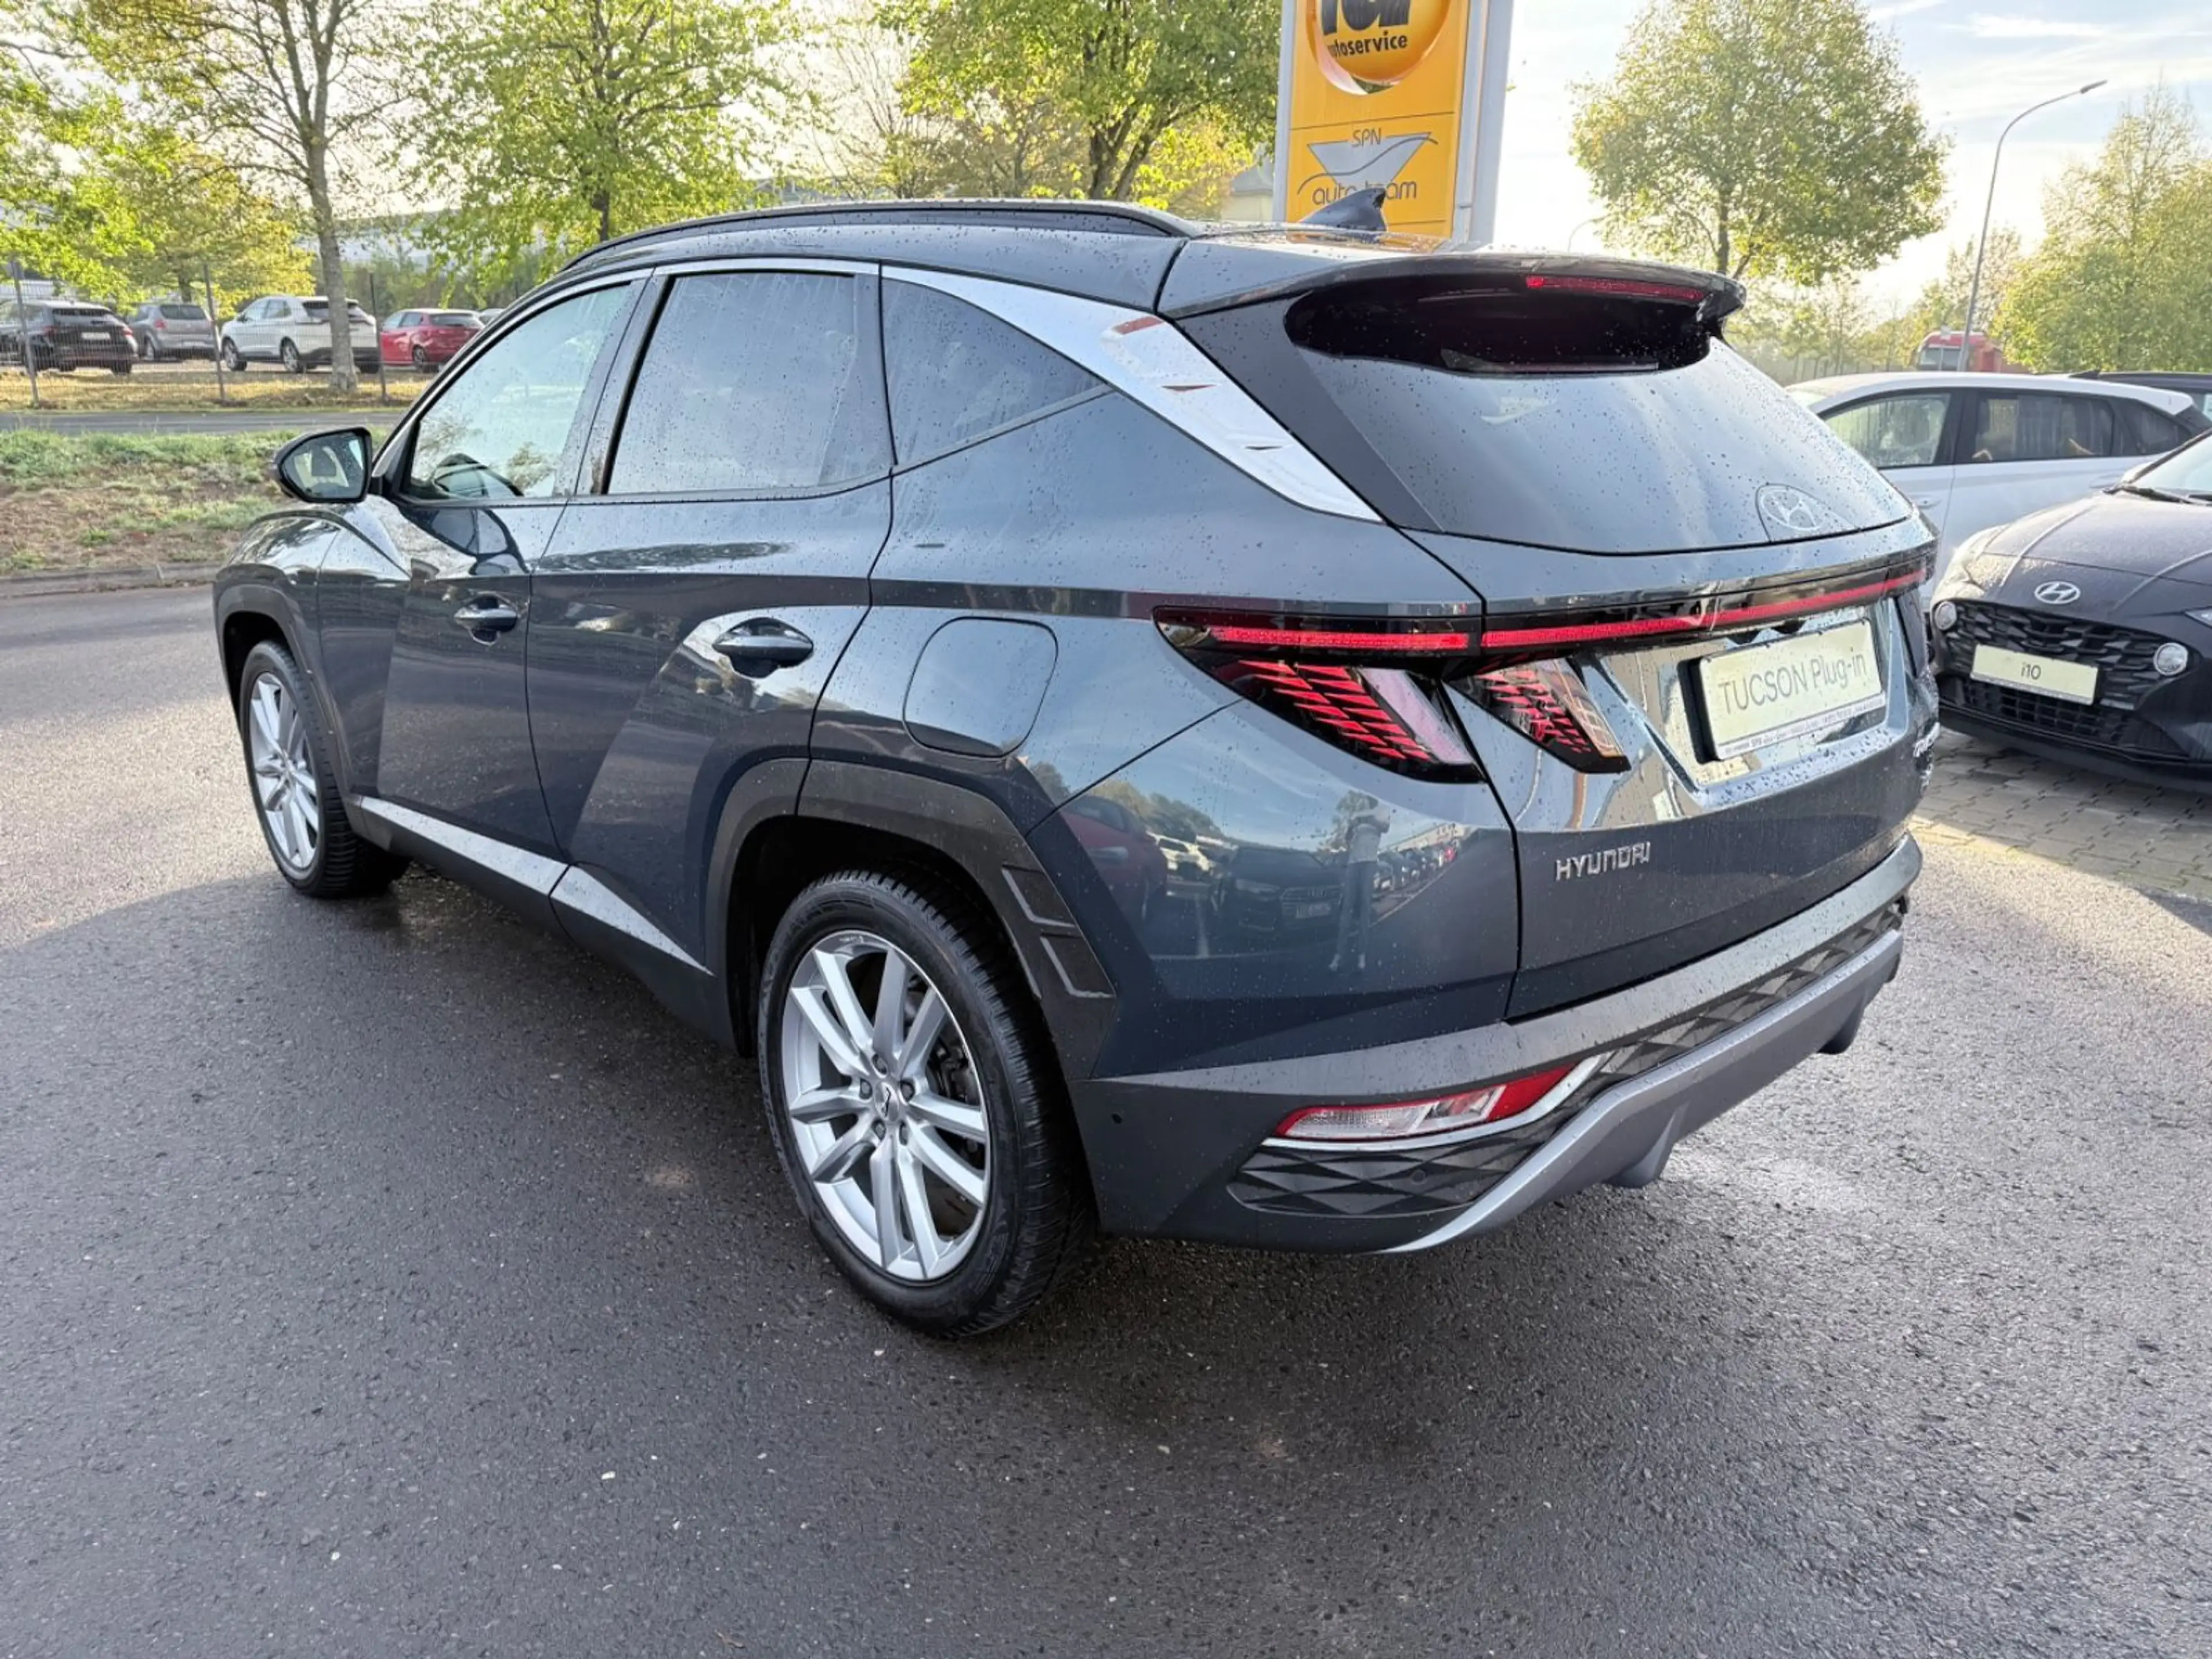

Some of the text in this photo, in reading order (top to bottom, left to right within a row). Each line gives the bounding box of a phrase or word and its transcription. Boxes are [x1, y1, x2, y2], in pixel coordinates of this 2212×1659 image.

[1352, 128, 1381, 148] SPN
[1365, 180, 1417, 200] am
[2021, 661, 2041, 680] i10
[1718, 653, 1867, 714] TUCSON Plug-in
[1556, 841, 1651, 881] HYUNDAI
